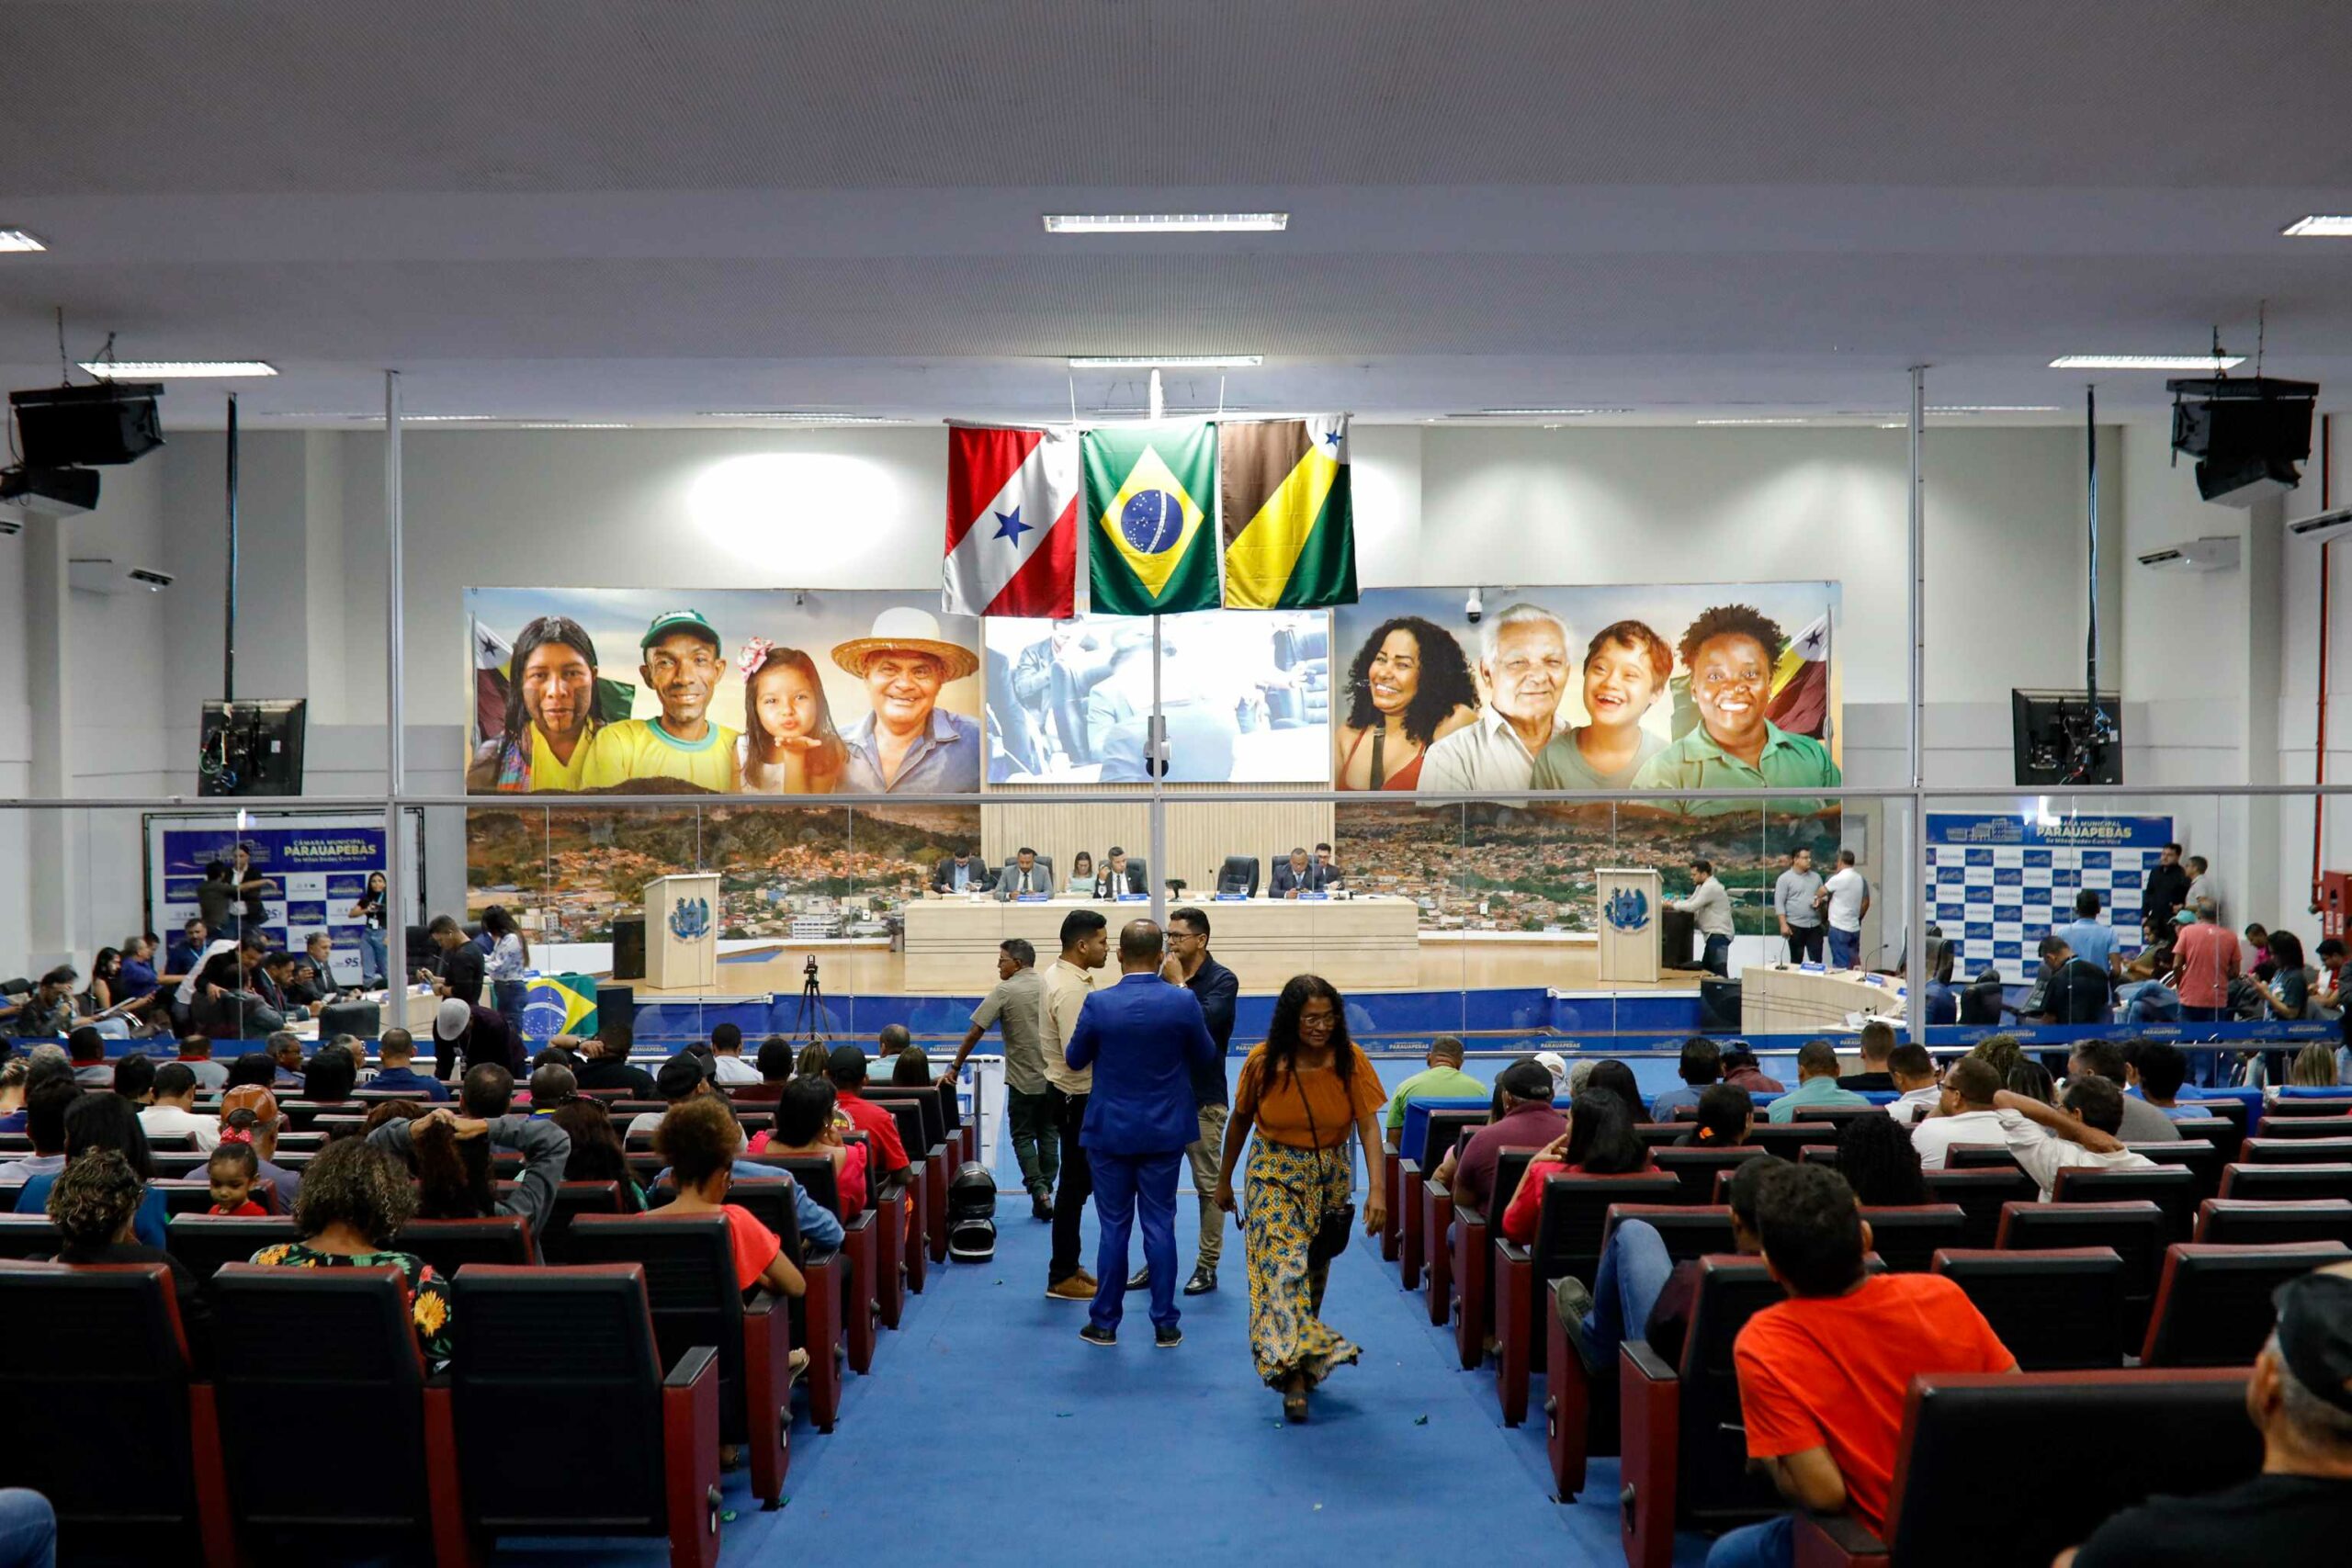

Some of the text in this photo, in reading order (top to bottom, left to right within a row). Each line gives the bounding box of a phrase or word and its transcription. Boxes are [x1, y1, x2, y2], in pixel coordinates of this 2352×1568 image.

[2036, 827, 2132, 838] PARAUAPEBAS
[284, 845, 377, 856] PARAUAPEBAS
[345, 957, 359, 967] 95
